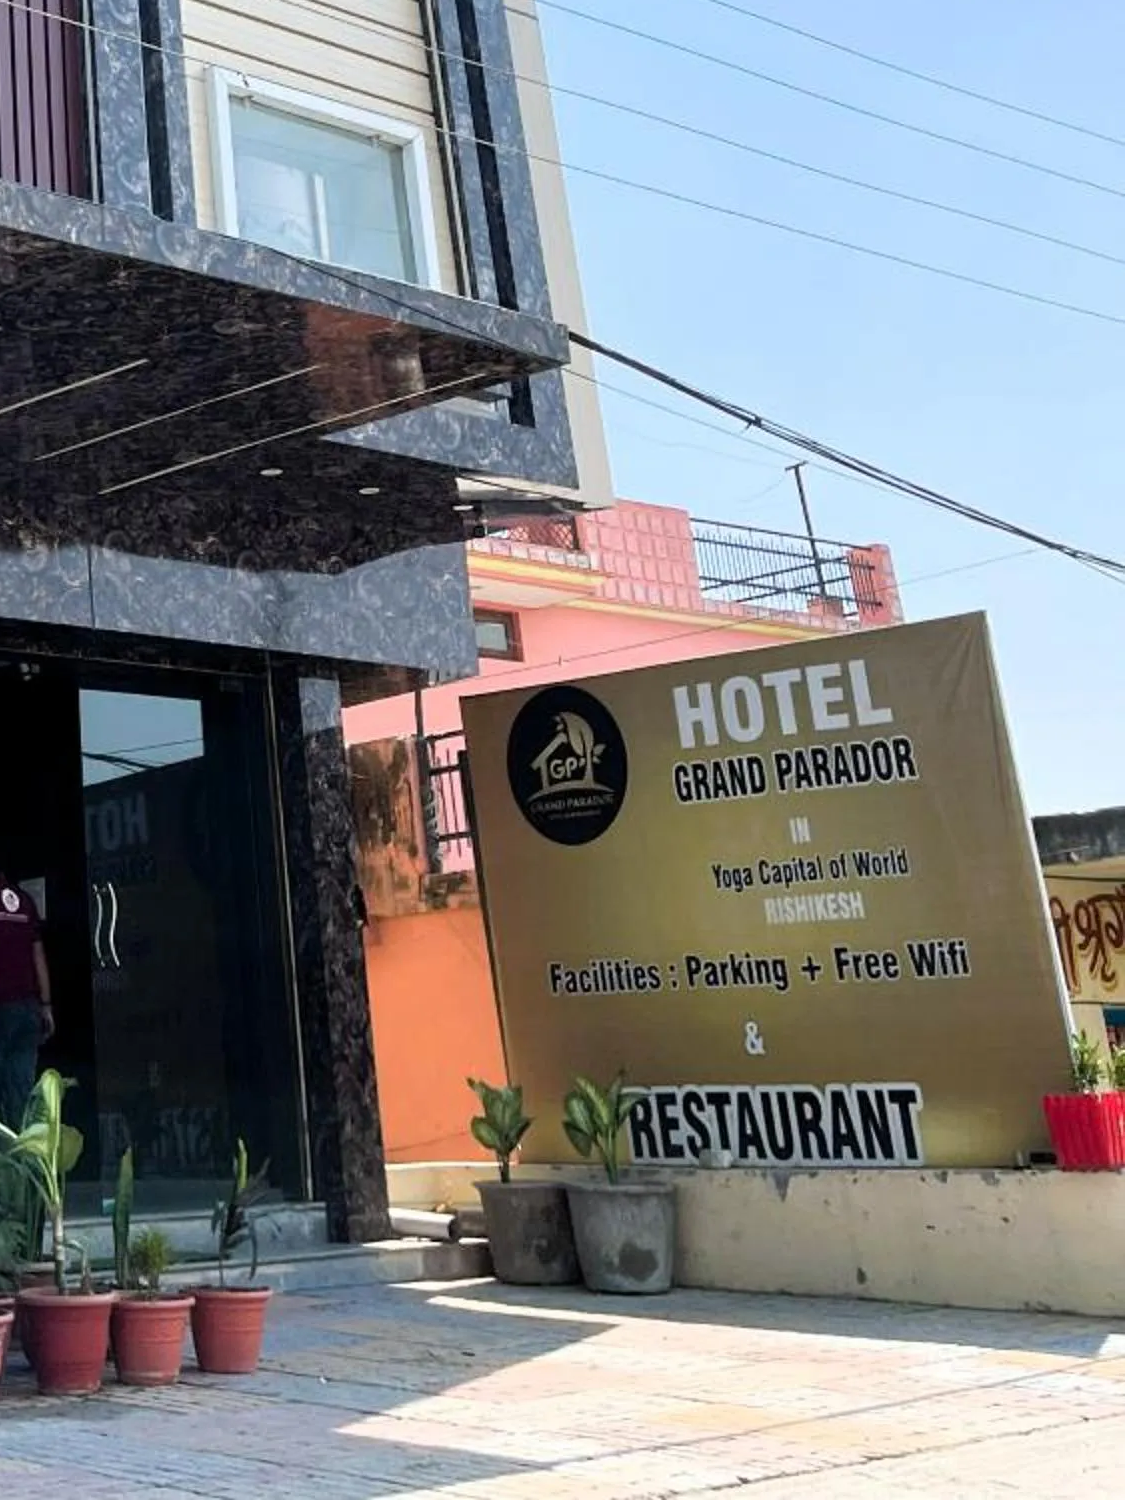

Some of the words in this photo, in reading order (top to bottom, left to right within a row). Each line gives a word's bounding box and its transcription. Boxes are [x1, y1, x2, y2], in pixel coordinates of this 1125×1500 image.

[672, 659, 894, 749] HOTEL
[673, 755, 767, 804] GRAND
[773, 736, 918, 792] PARADOR
[789, 817, 811, 845] IN
[711, 863, 754, 893] Yoga
[758, 855, 825, 889] Capital
[830, 852, 847, 879] of
[852, 847, 909, 878] World
[763, 891, 866, 925] RISHIKESH
[548, 959, 661, 995] Facilities
[683, 952, 790, 992] Parking
[832, 945, 900, 981] Free
[907, 938, 971, 978] Wifi
[744, 1021, 765, 1056] &
[626, 1084, 922, 1164] RESTAURANT
